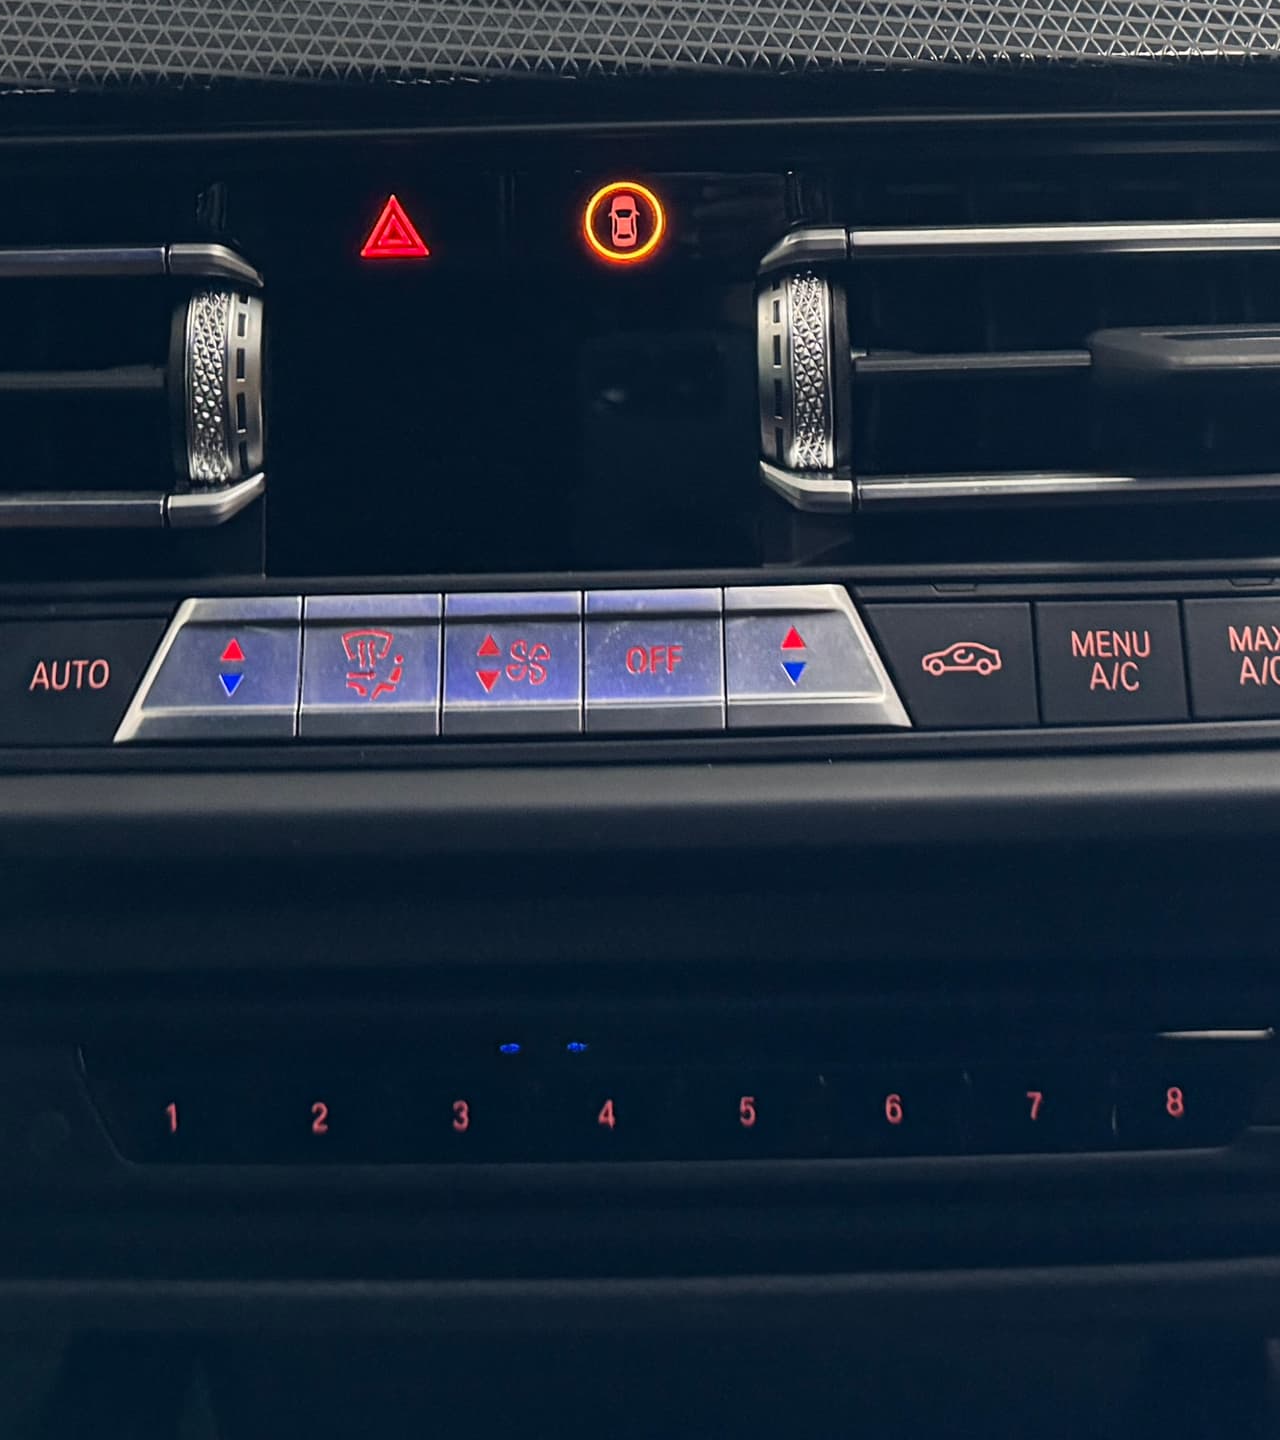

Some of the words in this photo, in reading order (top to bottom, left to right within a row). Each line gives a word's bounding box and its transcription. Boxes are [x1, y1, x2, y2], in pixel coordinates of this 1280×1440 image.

[1071, 630, 1151, 658] MENU
[29, 659, 110, 691] AUTO
[625, 646, 682, 675] OFF
[1090, 661, 1140, 692] A/C
[165, 1102, 179, 1133] 1
[312, 1102, 328, 1132] 2
[453, 1101, 469, 1130] 3
[598, 1098, 617, 1130] 4
[740, 1096, 756, 1126] 5
[885, 1094, 903, 1123] 6
[1027, 1091, 1042, 1120] 7
[1166, 1087, 1184, 1116] 8
